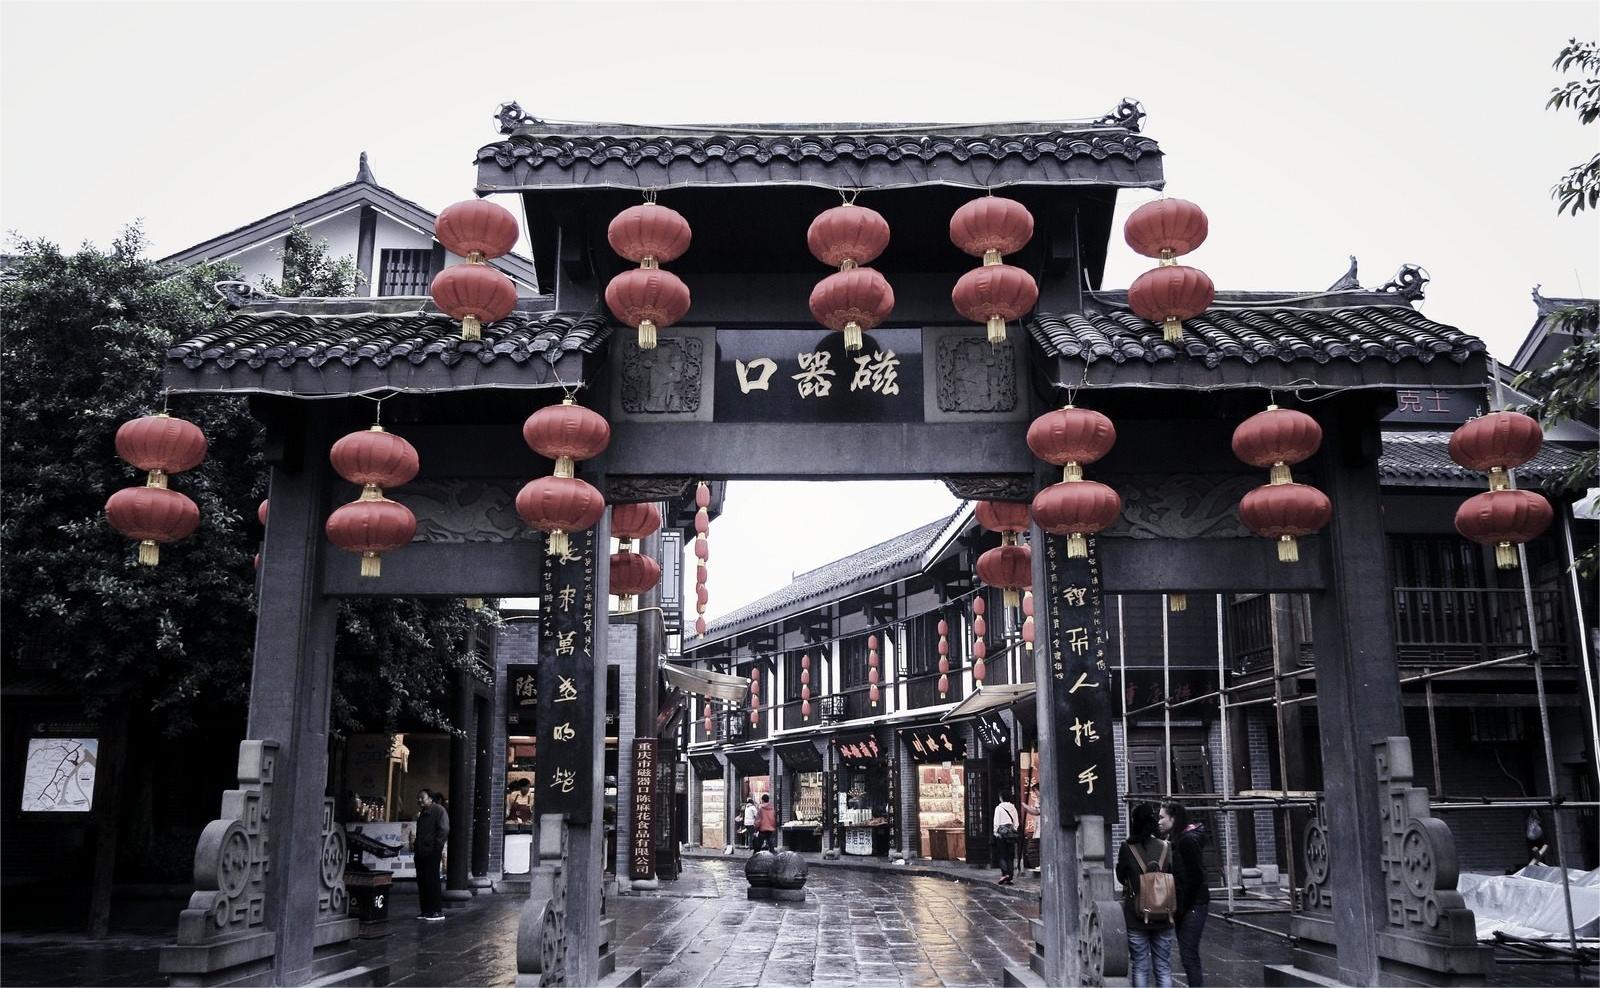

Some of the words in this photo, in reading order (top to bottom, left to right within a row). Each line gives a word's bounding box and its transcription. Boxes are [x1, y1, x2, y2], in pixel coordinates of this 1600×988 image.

[635, 742, 652, 875] 重庆市磁器口陈麻花食品有限公司
